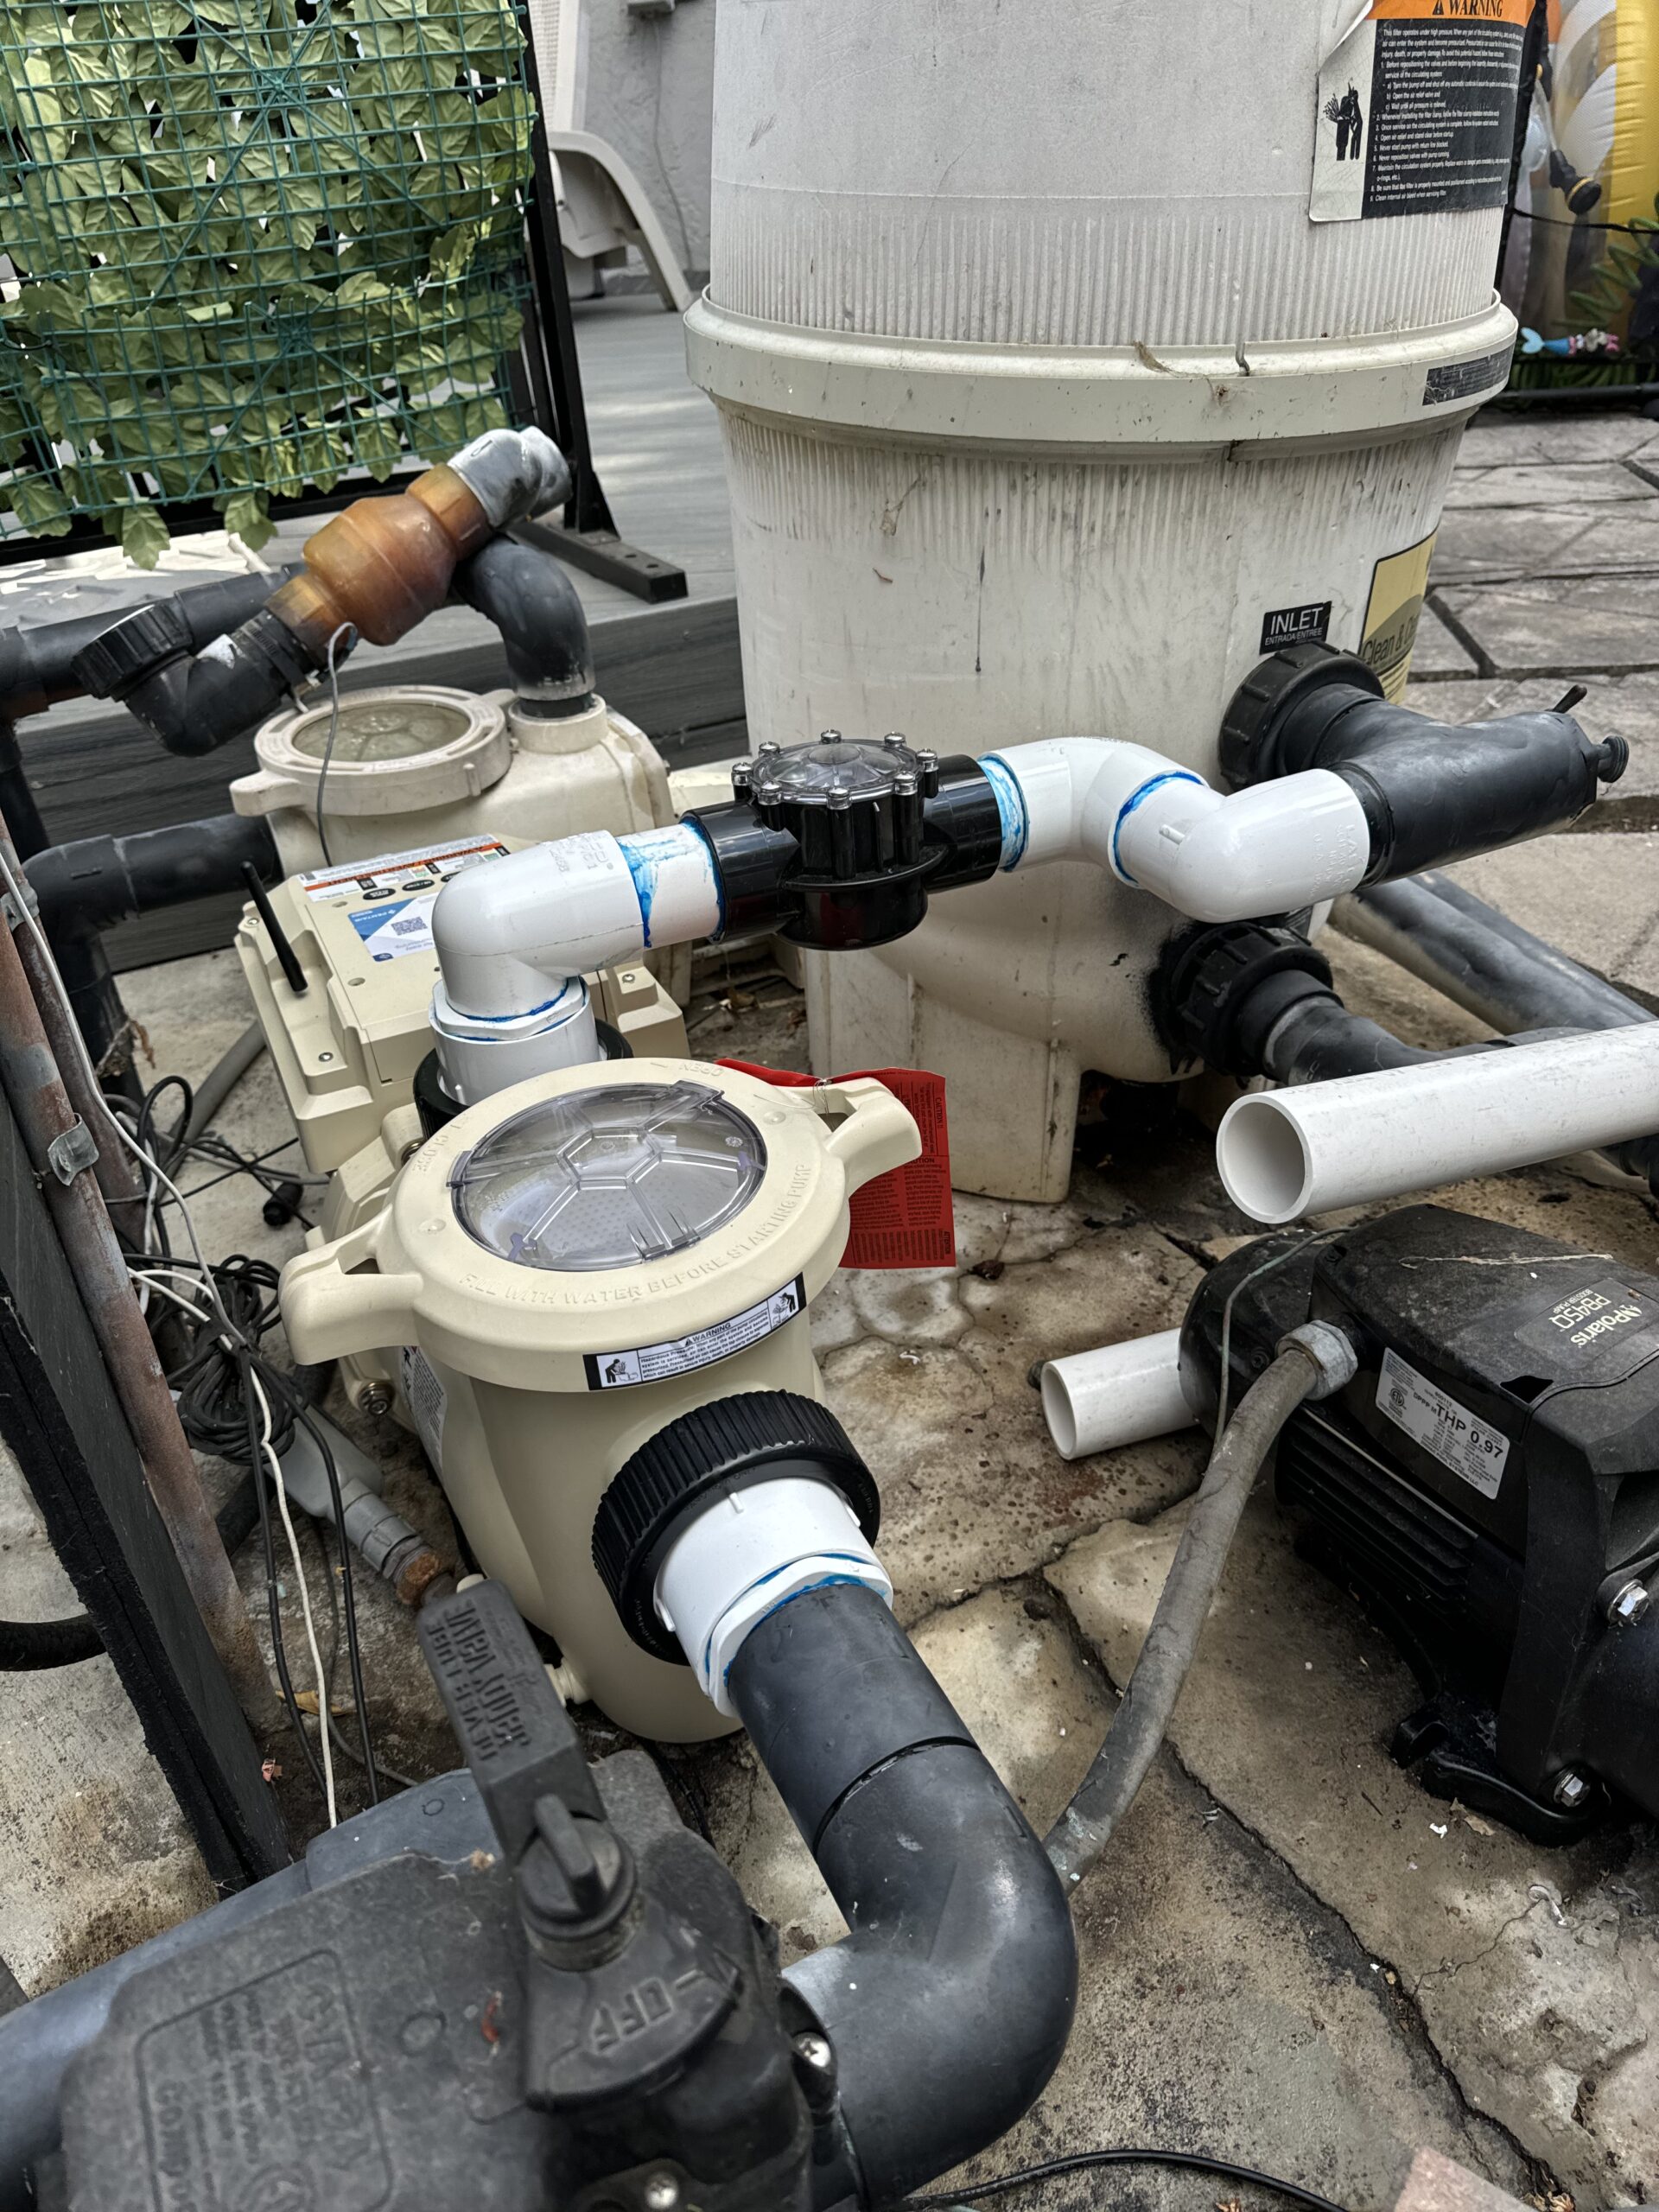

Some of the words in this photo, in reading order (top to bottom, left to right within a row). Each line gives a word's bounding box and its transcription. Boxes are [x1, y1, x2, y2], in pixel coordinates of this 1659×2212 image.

[1449, 0, 1503, 17] WARNING
[1269, 607, 1324, 635] INLET
[1265, 632, 1296, 645] ENTRADA
[1362, 633, 1395, 664] Clean
[505, 1285, 555, 1305] WITH
[563, 1285, 643, 1305] WATER
[648, 1255, 729, 1294] BEFORE
[727, 1200, 798, 1260] STARTING
[788, 1163, 813, 1198] PUMP
[1548, 1293, 1611, 1329] PB4SQ
[1569, 1288, 1594, 1303] BOOSTER
[692, 1322, 731, 1342] WARNING
[1570, 1309, 1632, 1346] Polaris
[1436, 1402, 1466, 1431] THP
[1471, 1430, 1503, 1459] 0.97
[591, 1976, 676, 2056] OFF
